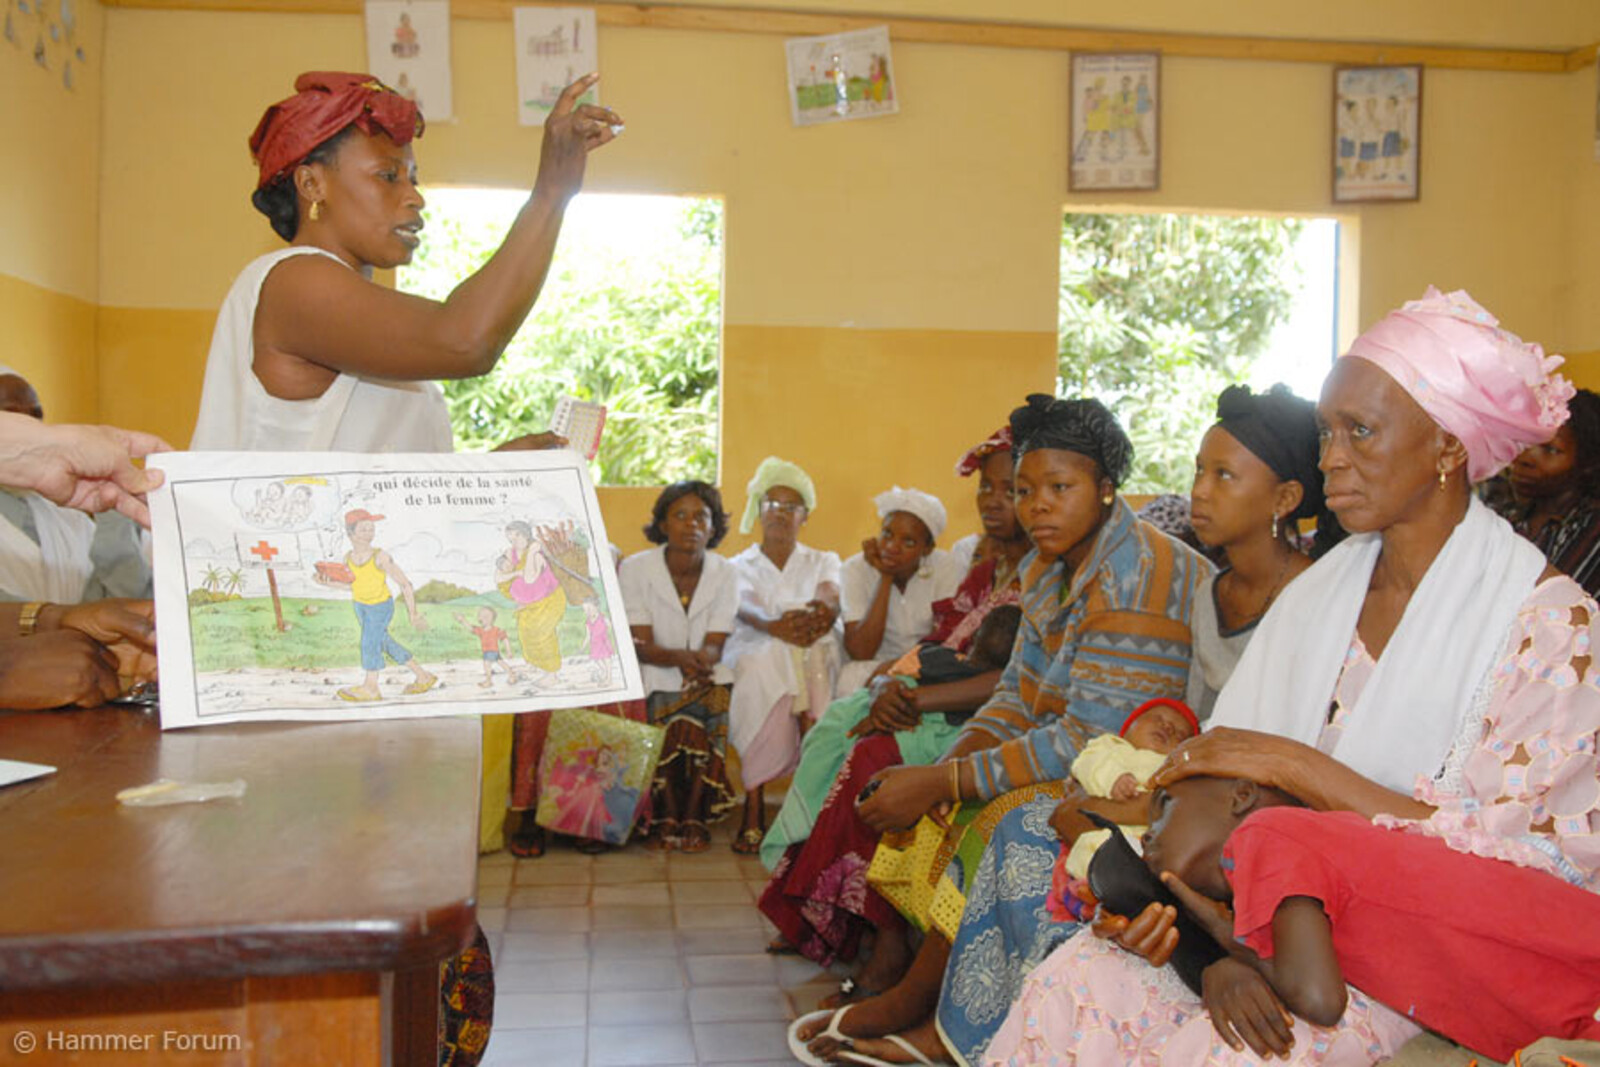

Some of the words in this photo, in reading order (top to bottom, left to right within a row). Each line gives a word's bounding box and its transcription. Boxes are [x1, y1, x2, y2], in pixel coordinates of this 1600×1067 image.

[373, 477, 398, 493] qui
[402, 476, 451, 489] décide
[456, 477, 475, 489] de
[477, 477, 491, 489] la
[494, 475, 533, 489] santé
[404, 494, 424, 506] de
[427, 493, 442, 506] la
[446, 493, 496, 506] femme
